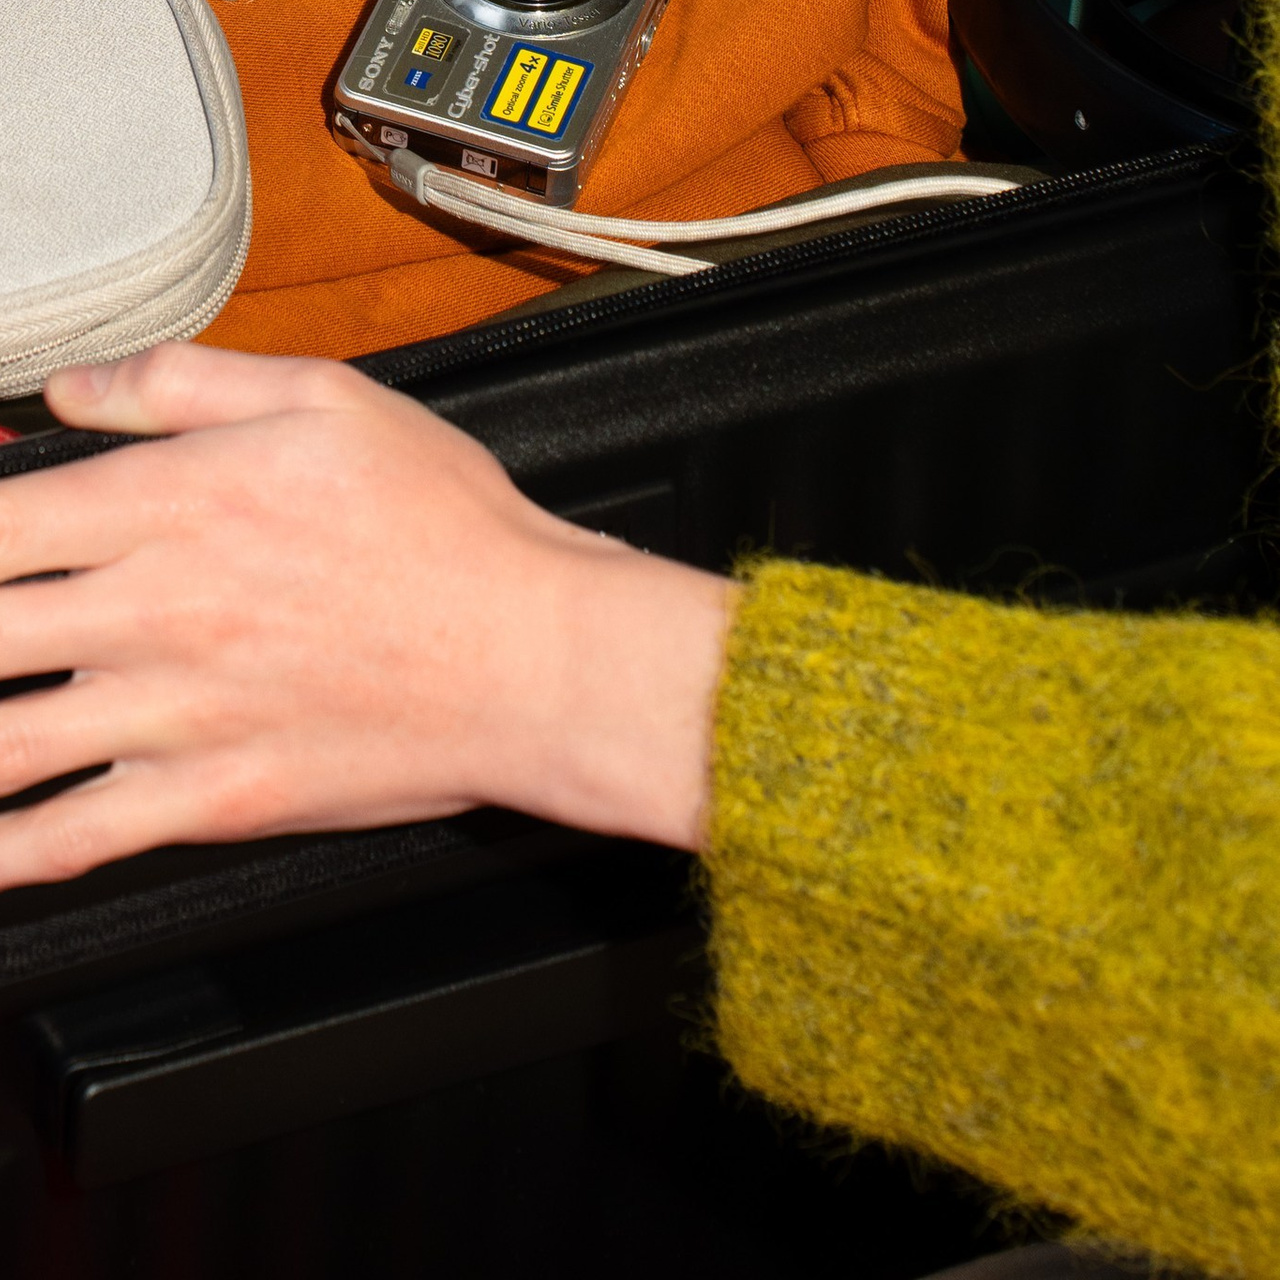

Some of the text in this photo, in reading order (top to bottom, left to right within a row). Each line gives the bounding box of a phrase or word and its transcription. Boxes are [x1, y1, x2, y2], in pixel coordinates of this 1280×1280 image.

[358, 36, 394, 92] SONY
[426, 34, 448, 59] 1080
[410, 70, 423, 87] ZEISS
[447, 33, 500, 119] Cyber-shot
[502, 55, 541, 116] Optical zoom 4x
[546, 66, 575, 112] Smile Shutter
[391, 169, 413, 188] SONY
